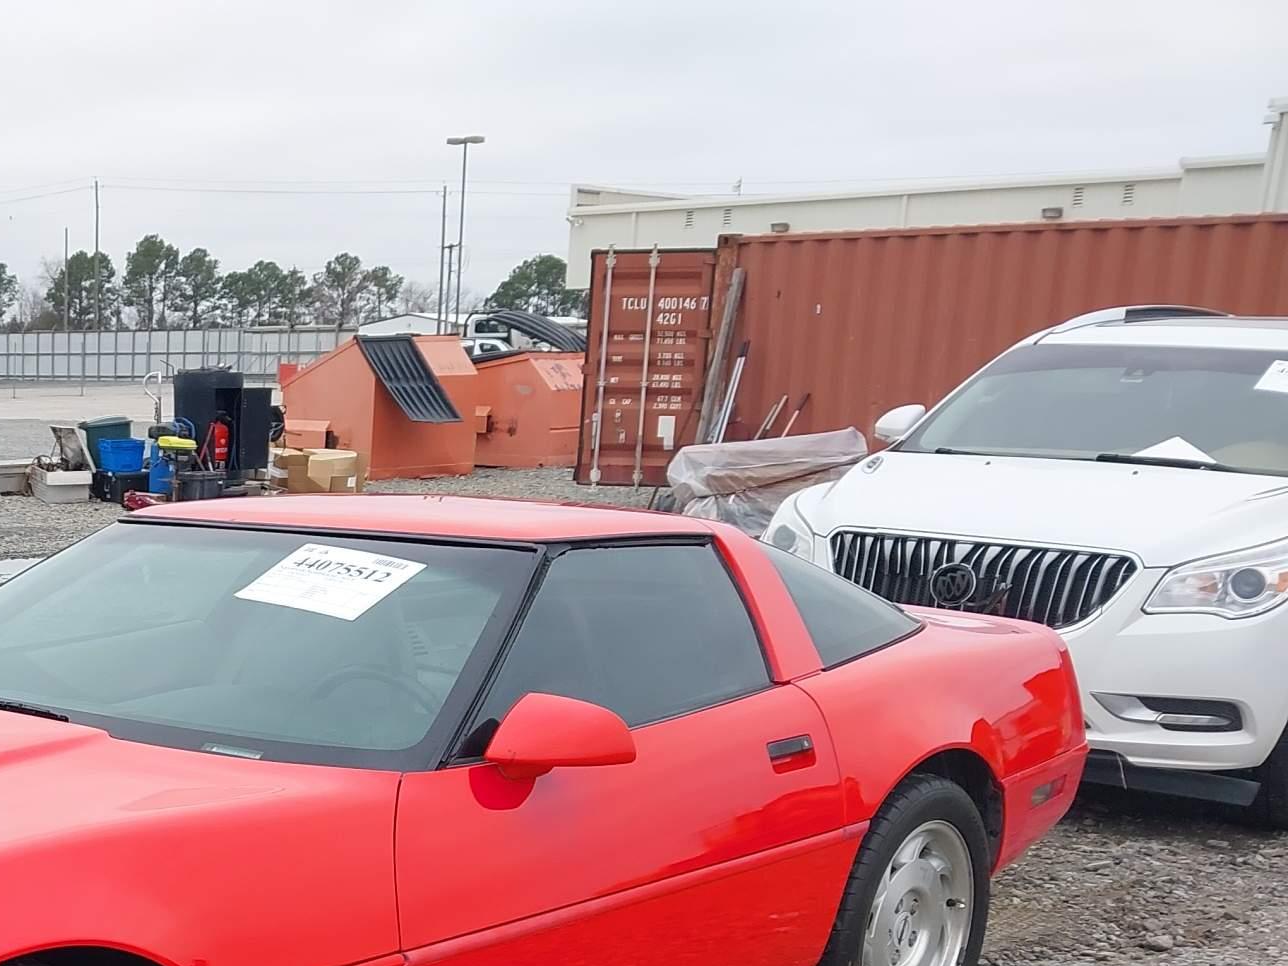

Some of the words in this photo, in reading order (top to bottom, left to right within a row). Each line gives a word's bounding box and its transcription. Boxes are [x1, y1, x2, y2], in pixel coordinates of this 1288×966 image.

[621, 297, 648, 310] TCLU
[657, 297, 697, 310] 400146
[700, 296, 709, 310] 7
[294, 556, 392, 583] 44075512
